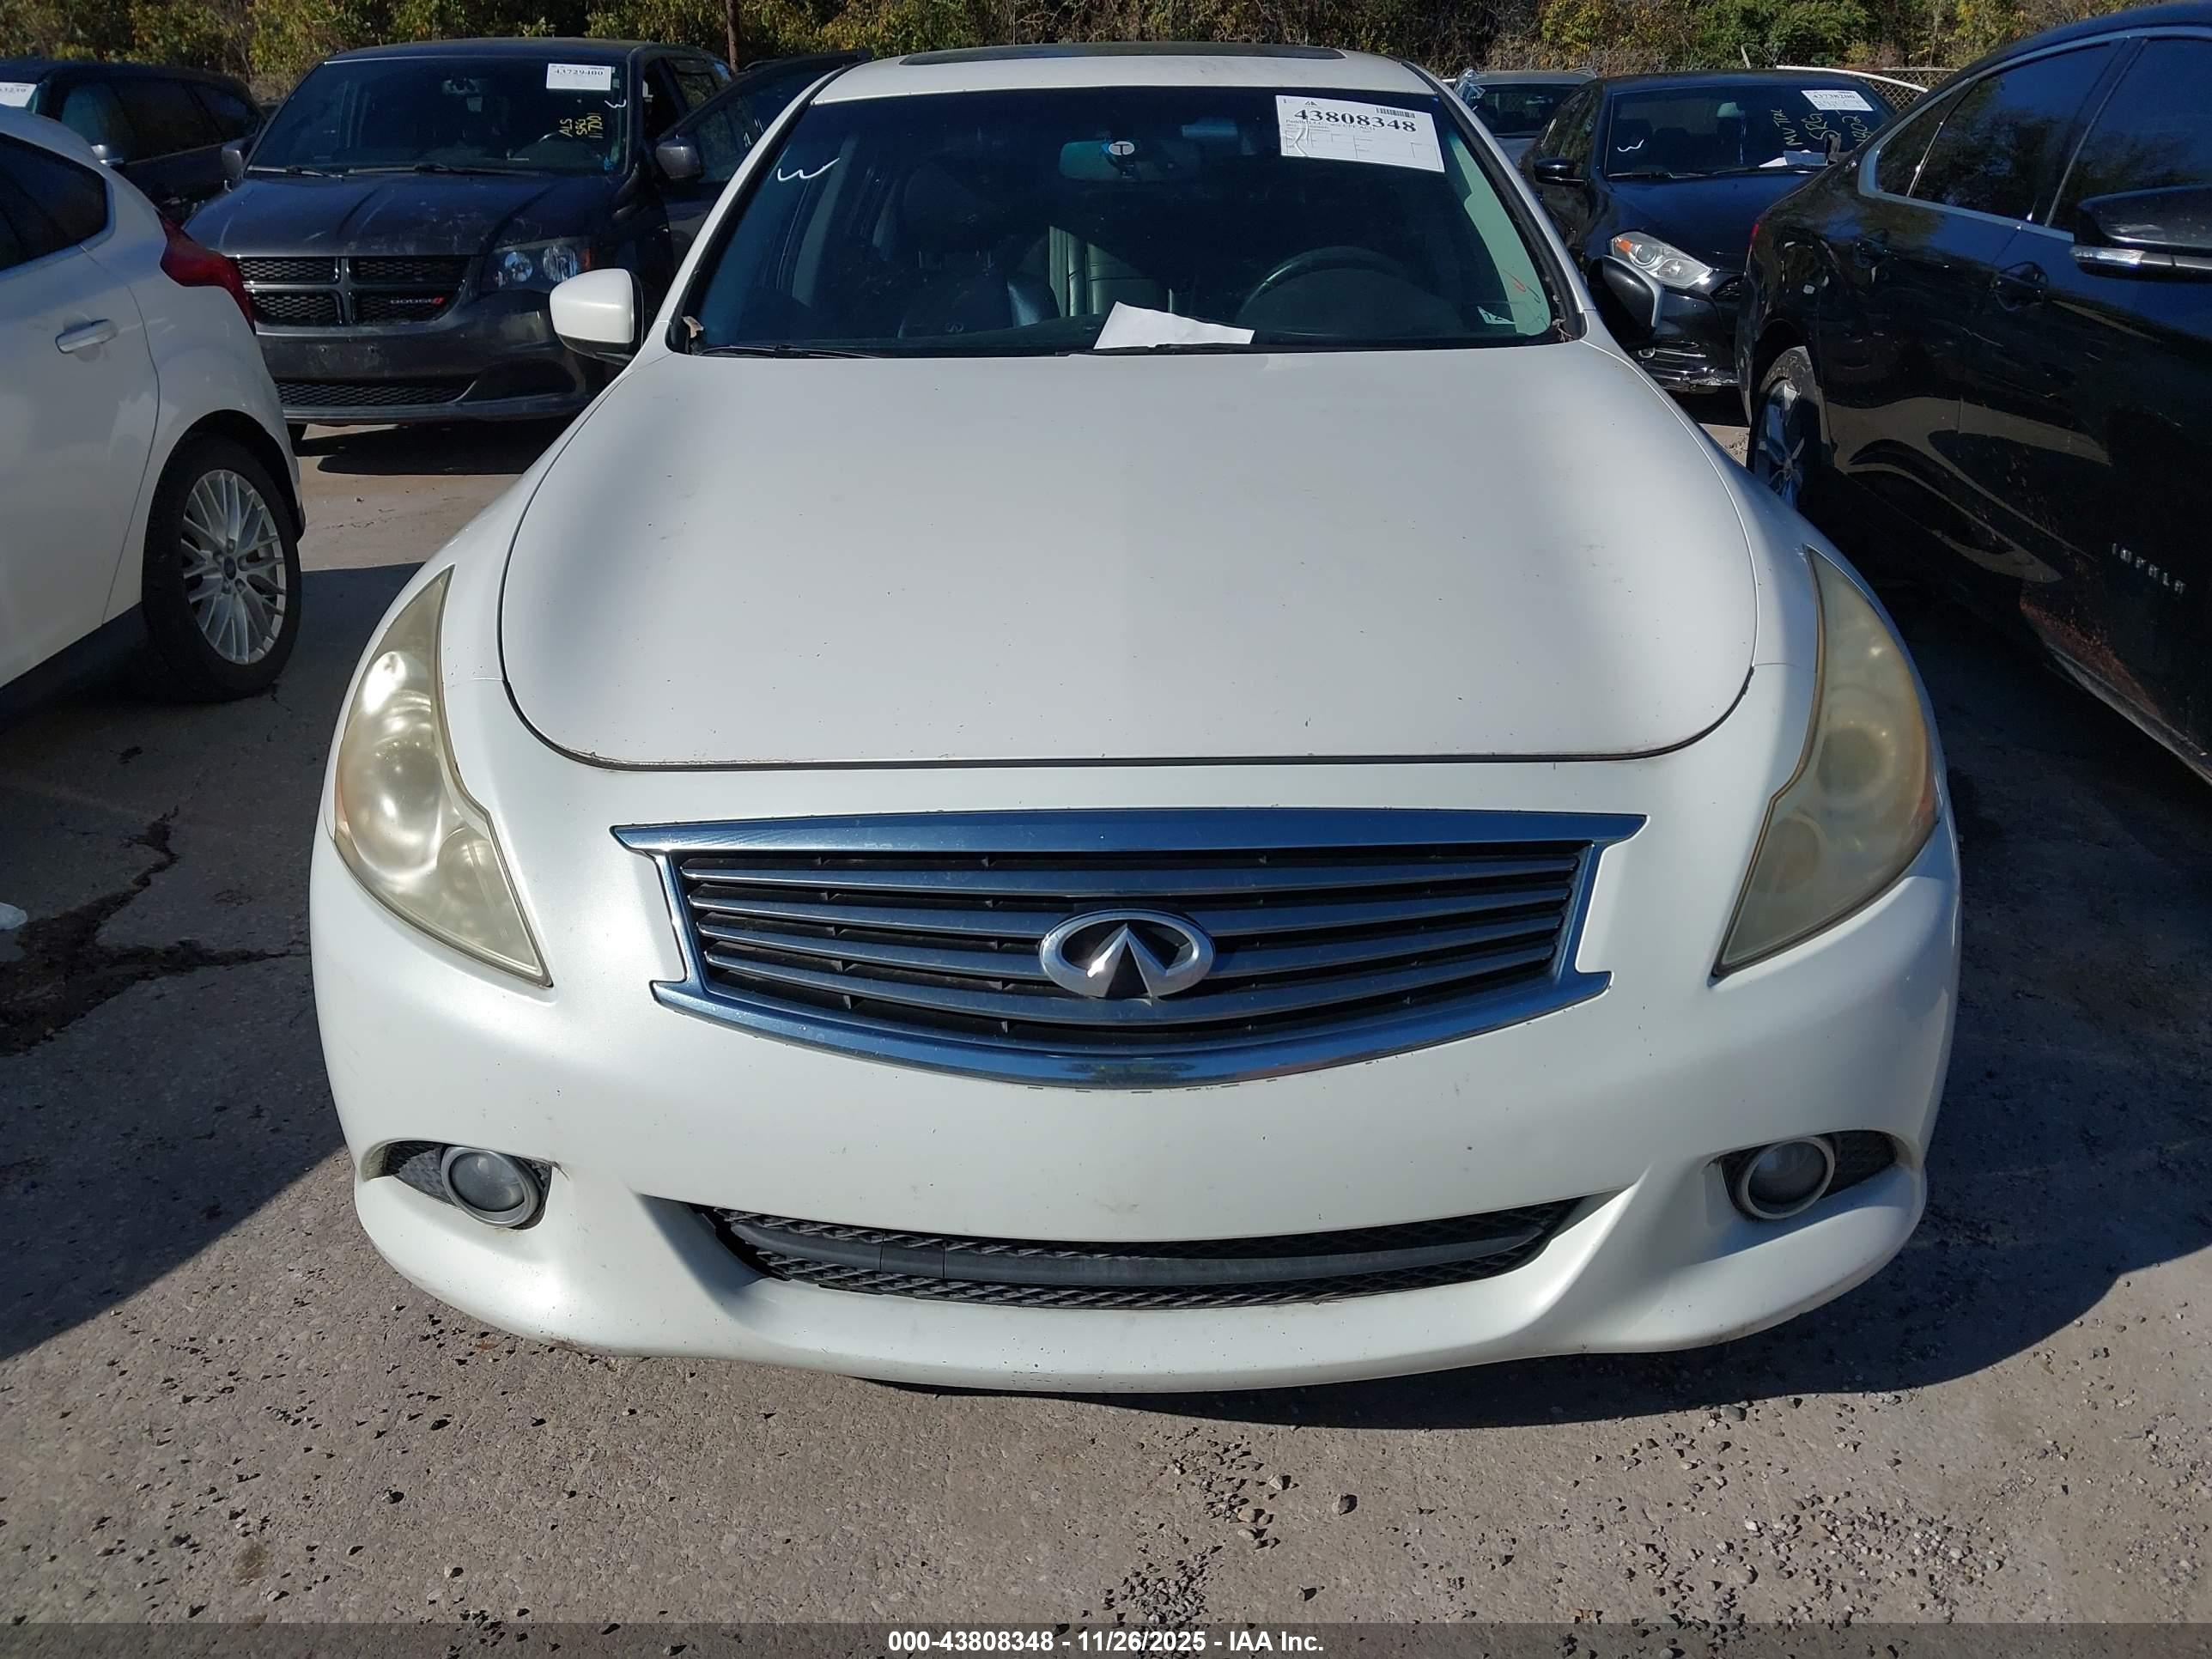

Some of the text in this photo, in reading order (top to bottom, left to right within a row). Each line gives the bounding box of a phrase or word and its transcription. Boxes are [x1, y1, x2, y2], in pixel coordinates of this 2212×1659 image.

[1294, 108, 1417, 132] 43808348
[1801, 112, 1842, 141] SRG
[2112, 543, 2185, 594] IMPALA
